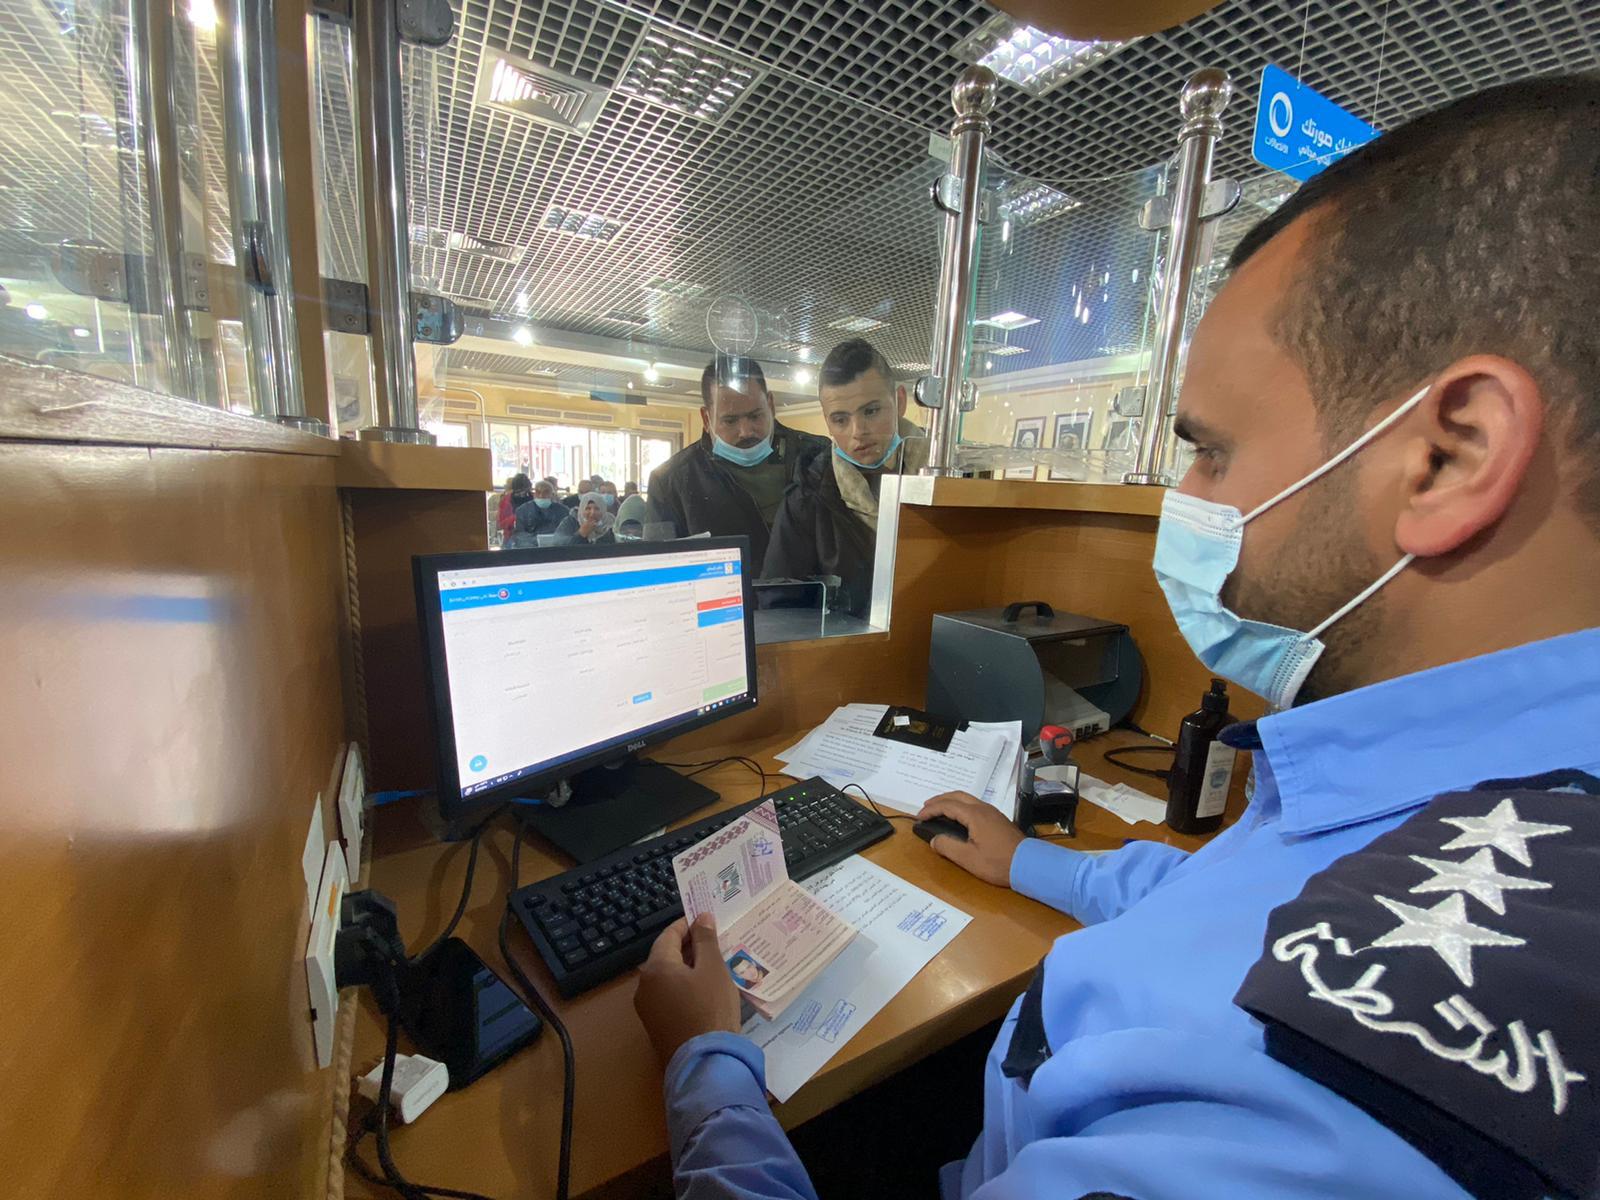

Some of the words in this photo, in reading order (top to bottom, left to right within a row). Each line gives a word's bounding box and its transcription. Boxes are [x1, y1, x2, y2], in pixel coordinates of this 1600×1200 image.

[1301, 118, 1333, 148] صورتك
[627, 739, 647, 753] DELL
[1272, 921, 1587, 1116] الشرطة
